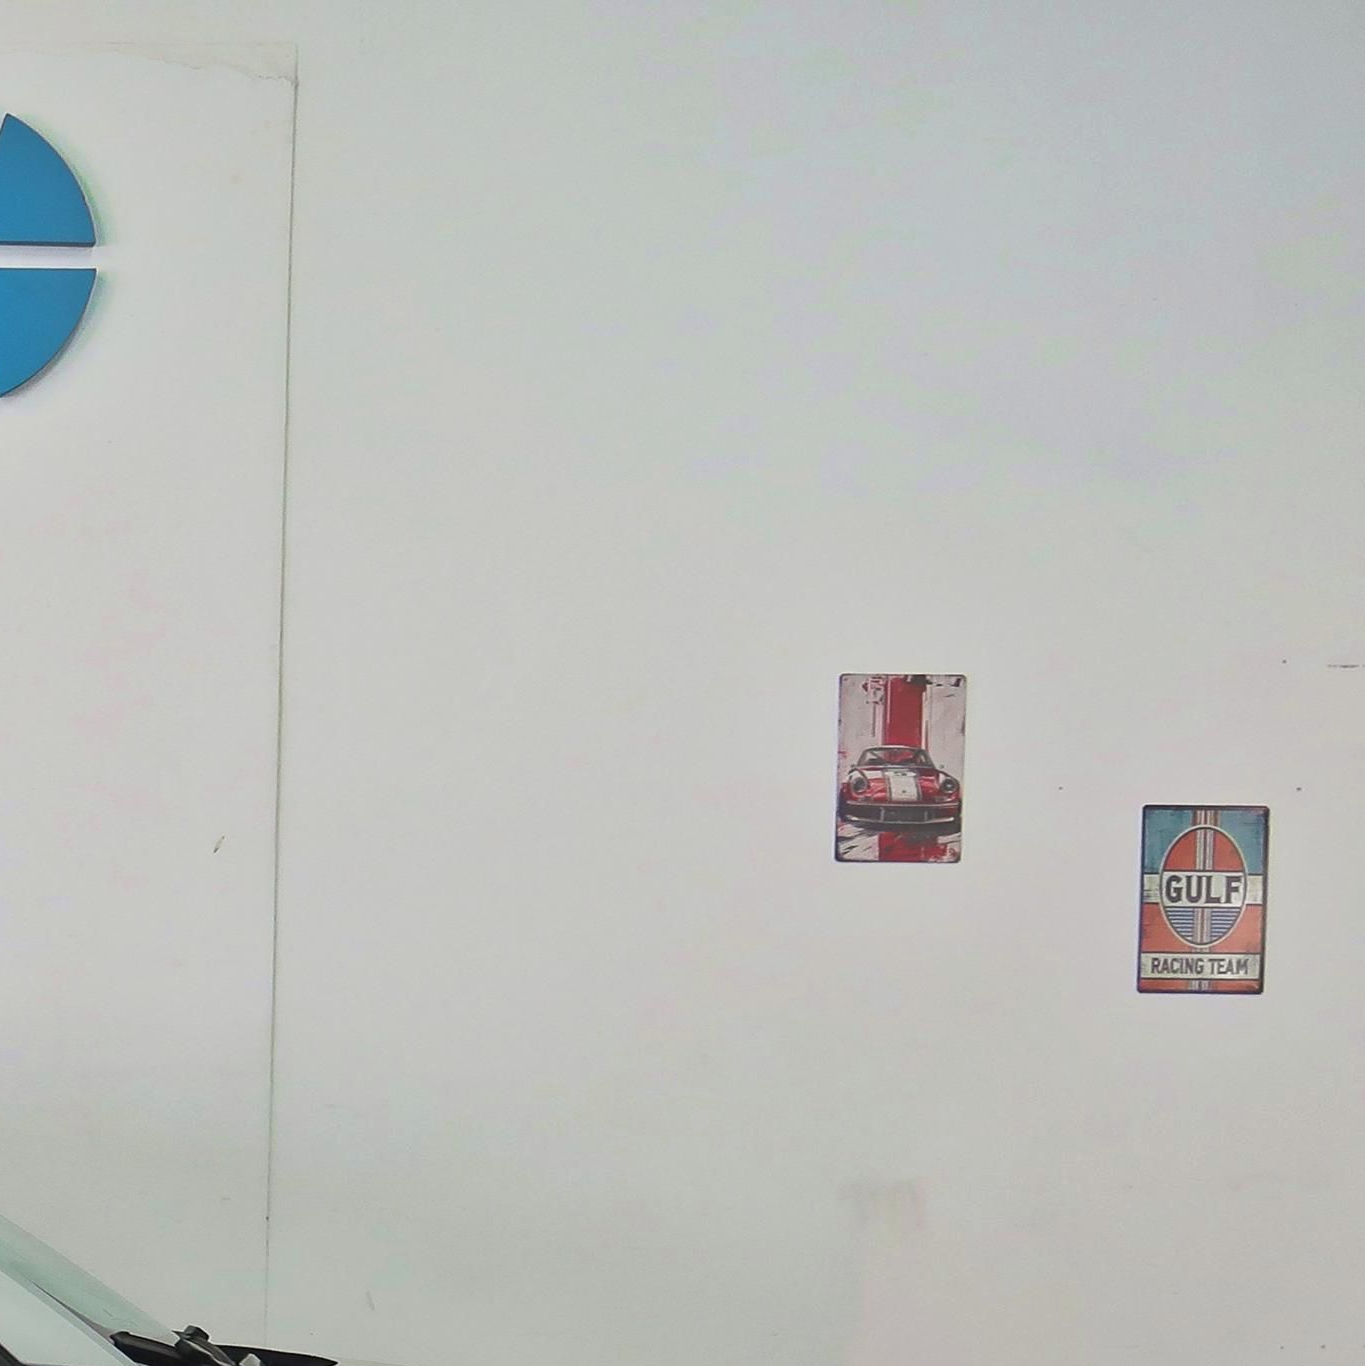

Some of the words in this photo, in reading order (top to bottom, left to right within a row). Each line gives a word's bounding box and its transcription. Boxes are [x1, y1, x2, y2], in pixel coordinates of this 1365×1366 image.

[1165, 875, 1242, 904] GULF
[1151, 957, 1204, 974] RACING
[1208, 957, 1249, 975] TEAM
